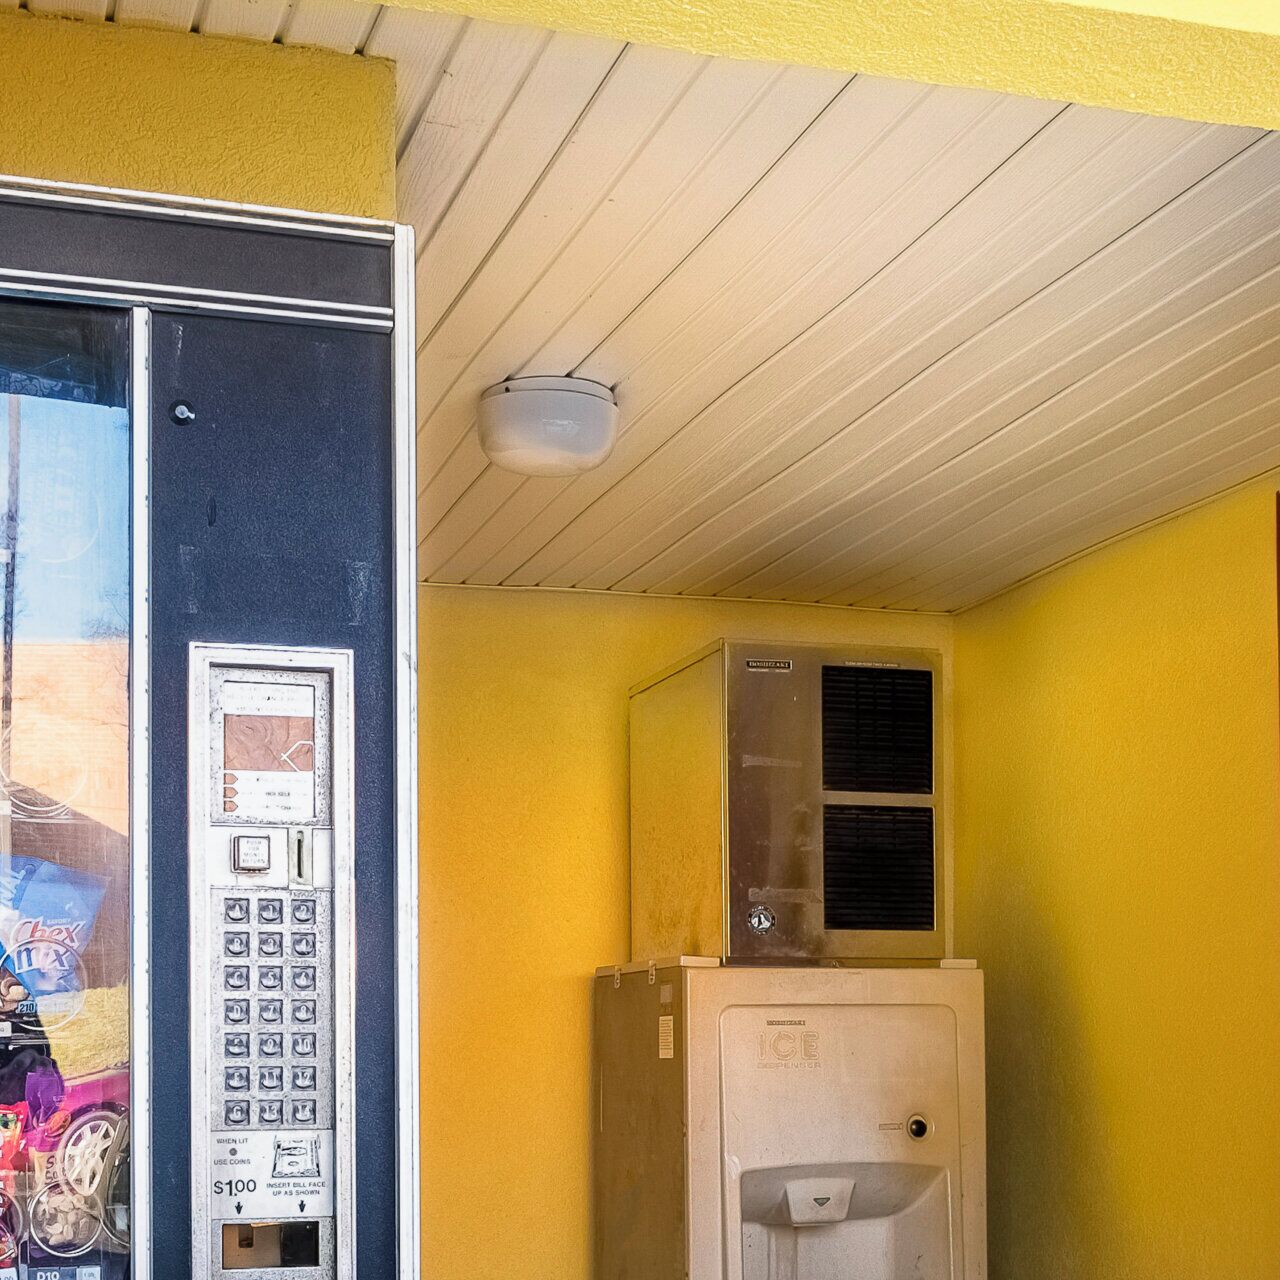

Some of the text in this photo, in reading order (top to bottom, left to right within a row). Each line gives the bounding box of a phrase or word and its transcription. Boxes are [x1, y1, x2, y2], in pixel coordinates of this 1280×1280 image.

[13, 918, 87, 946] Chex
[20, 1003, 35, 1013] 210
[757, 1030, 819, 1061] ICE
[216, 1137, 249, 1145] WHEN LIT
[214, 1158, 251, 1166] USE COINS
[213, 1179, 257, 1198] $1.00
